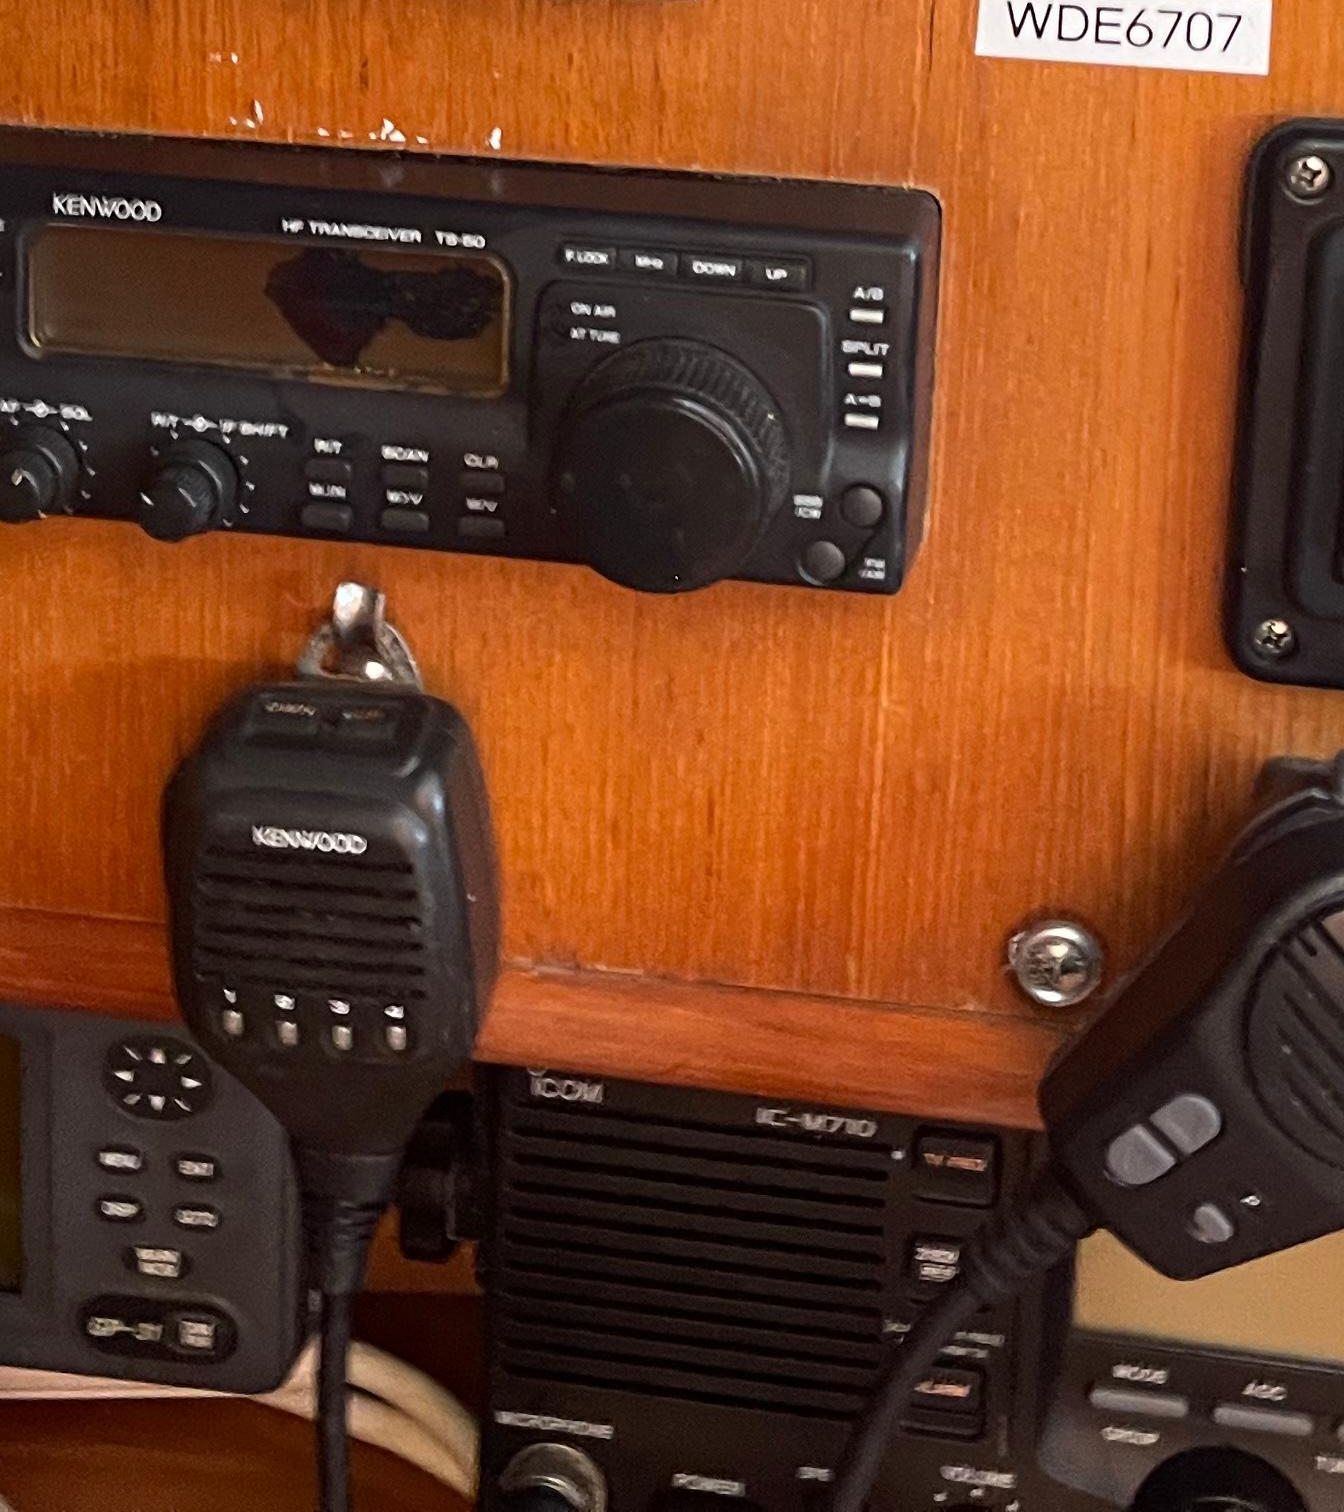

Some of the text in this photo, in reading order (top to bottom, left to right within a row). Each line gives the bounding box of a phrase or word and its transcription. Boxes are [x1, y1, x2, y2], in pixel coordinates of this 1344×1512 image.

[1007, 0, 1243, 53] WDE6707
[52, 191, 163, 224] KENWOOD
[765, 265, 789, 281] UP
[251, 824, 368, 855] KENWOOD
